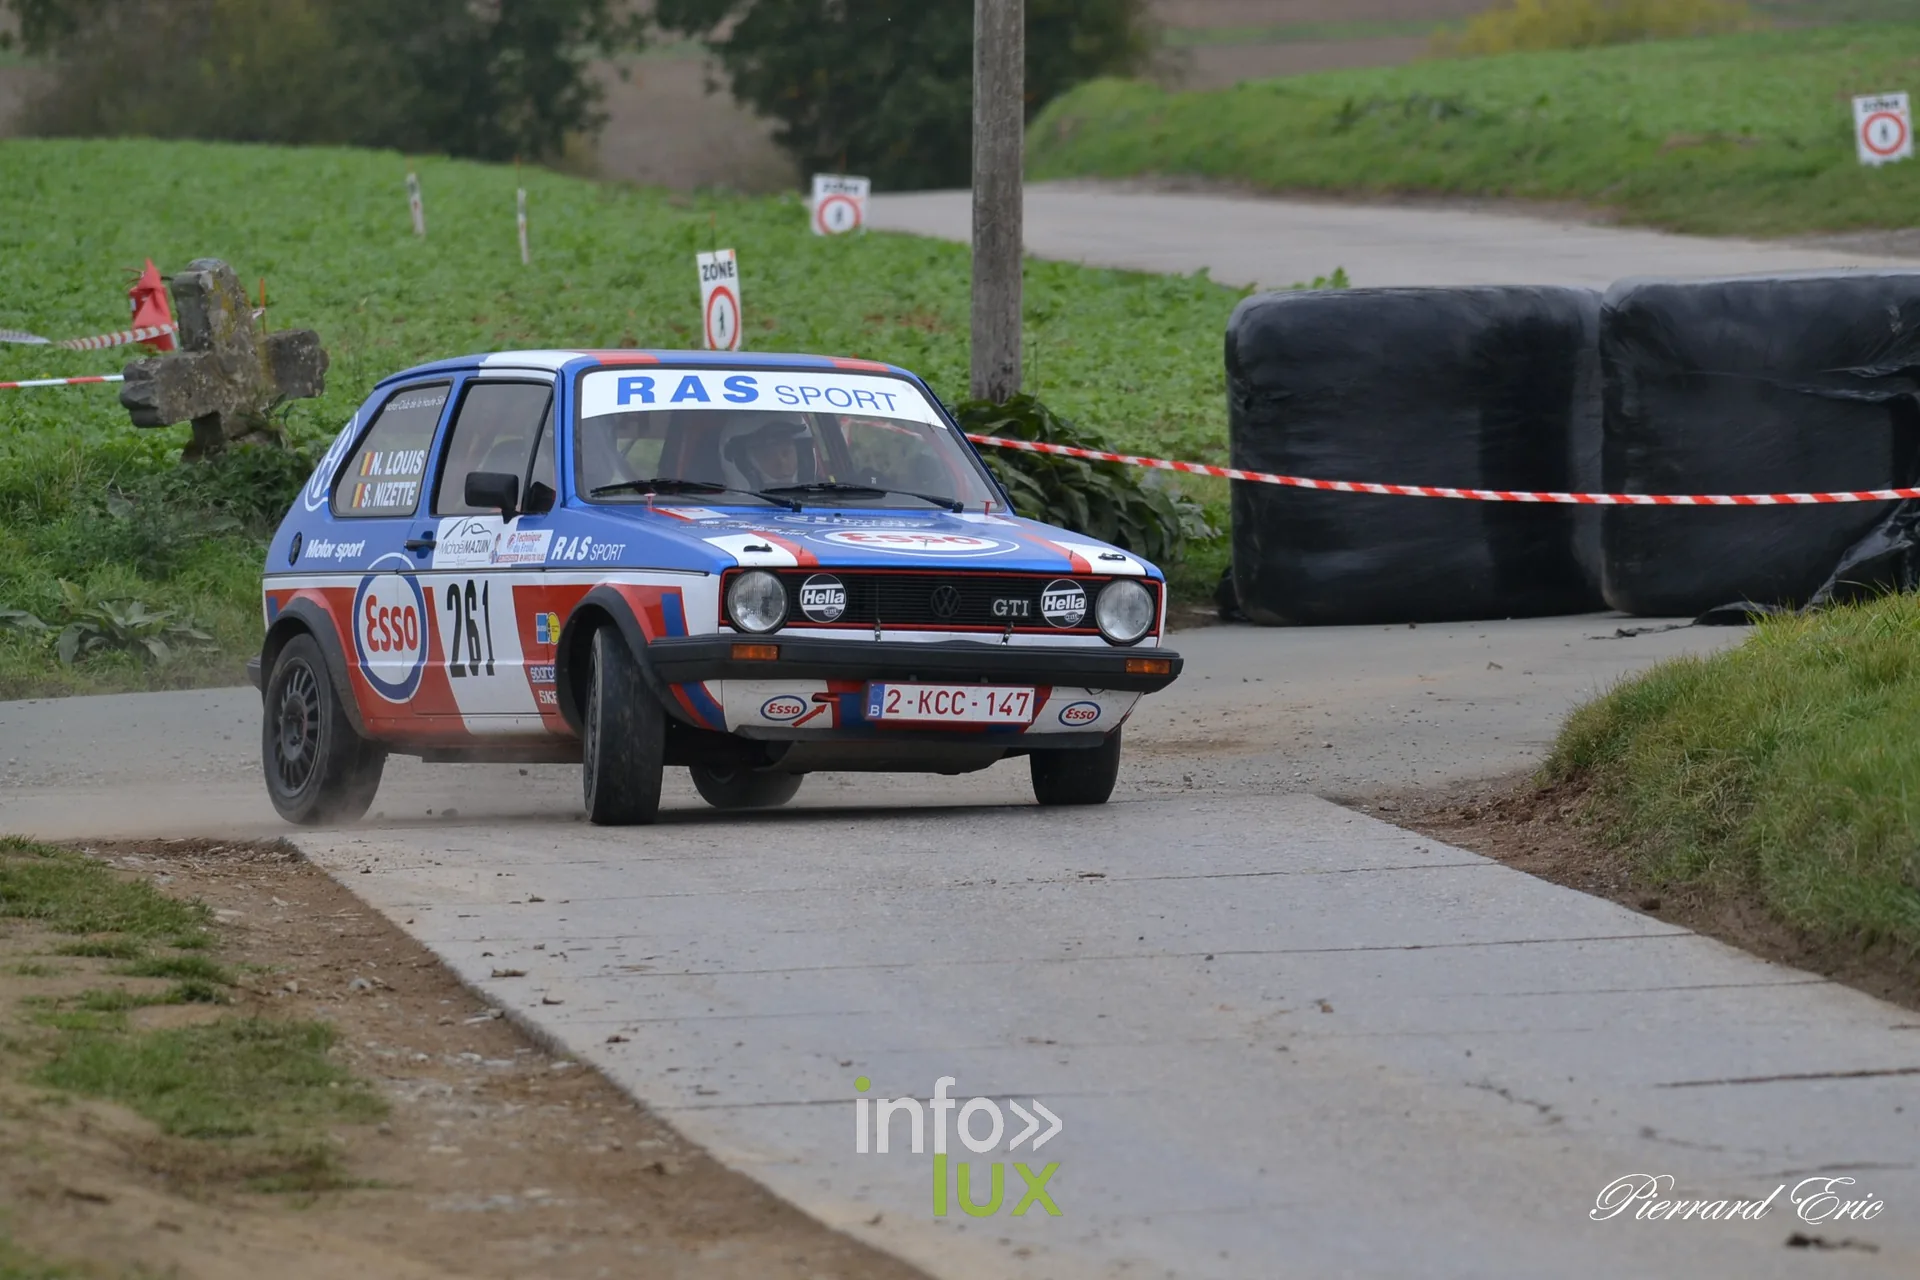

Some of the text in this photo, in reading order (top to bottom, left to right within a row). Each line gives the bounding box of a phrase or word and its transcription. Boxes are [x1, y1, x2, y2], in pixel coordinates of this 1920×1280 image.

[702, 260, 735, 281] ZONE
[616, 375, 897, 412] RAS SPORT
[369, 450, 425, 475] N. LOUIS
[361, 481, 417, 508] S. NIZETTE
[550, 536, 593, 561] RAS
[589, 544, 626, 561] SPORT
[837, 531, 982, 546] Esso
[304, 539, 366, 563] Motor sport
[803, 589, 845, 604] Hella
[1043, 595, 1085, 611] Hella
[993, 599, 1029, 616] GTI
[365, 594, 418, 652] Esso
[446, 579, 495, 678] 261
[768, 703, 800, 715] Esso
[869, 704, 880, 717] B
[1065, 708, 1095, 720] Esso
